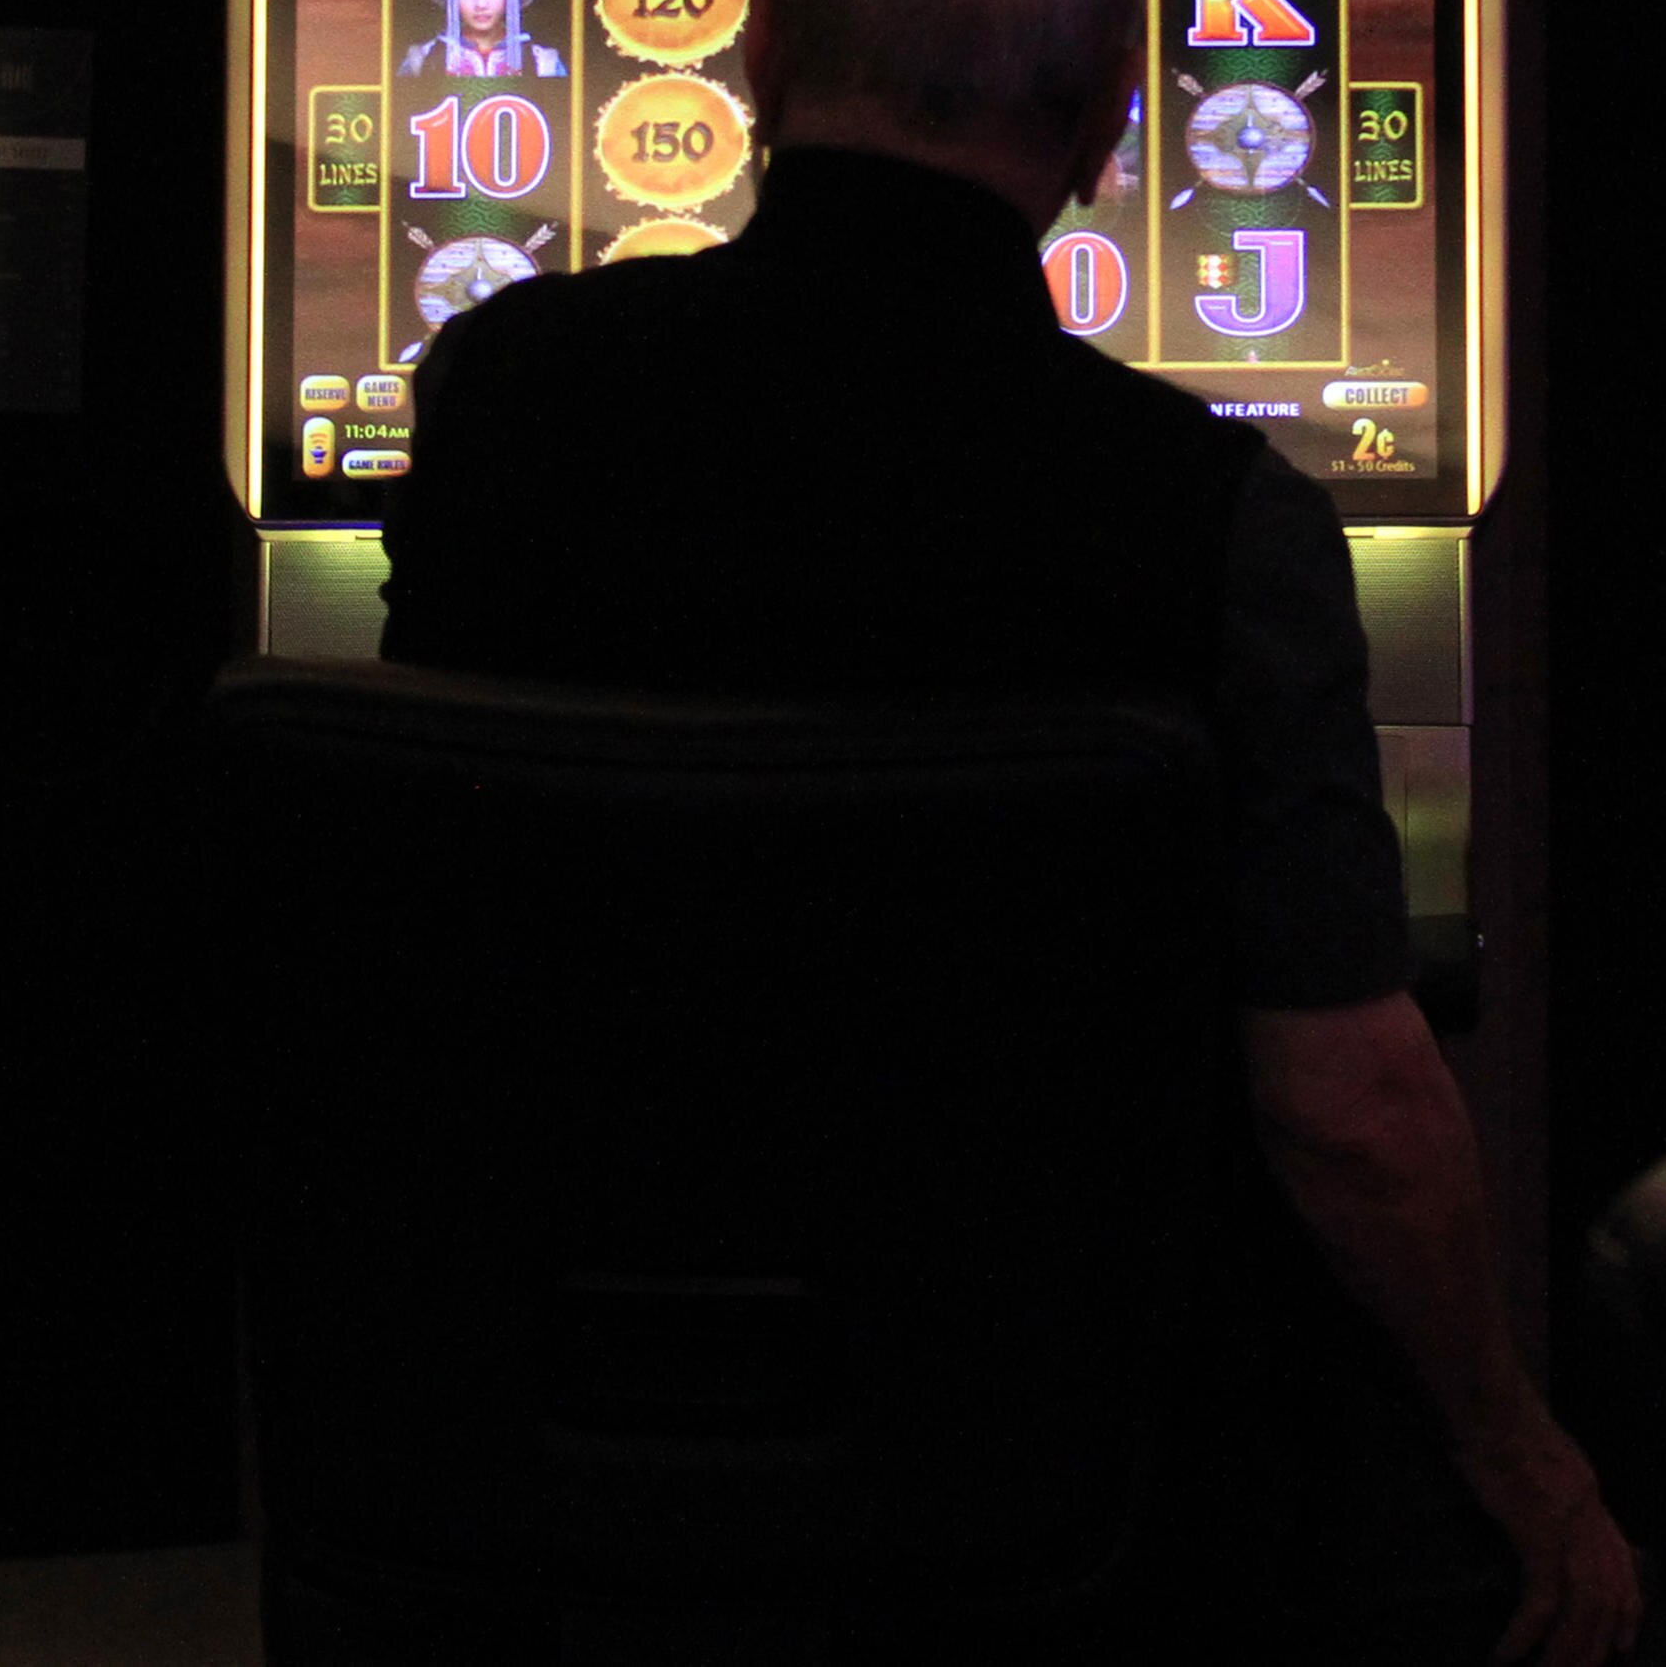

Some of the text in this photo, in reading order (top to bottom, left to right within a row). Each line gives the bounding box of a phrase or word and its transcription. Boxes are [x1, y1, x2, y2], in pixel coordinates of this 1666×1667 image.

[325, 113, 374, 145] 30
[1358, 109, 1409, 142] 30
[409, 94, 551, 199] 10
[632, 121, 715, 162] 150
[319, 162, 379, 185] LINES
[1354, 159, 1414, 182] LINES
[1041, 231, 1127, 335] 0
[1194, 229, 1306, 336] J
[364, 382, 399, 393] GAMES
[1345, 388, 1408, 404] COLLECT
[367, 395, 396, 407] MENU
[1224, 402, 1301, 417] FEATURE
[349, 460, 374, 470] GAME
[1331, 460, 1345, 471] $1
[1357, 460, 1373, 471] 50
[1375, 460, 1415, 472] Credits
